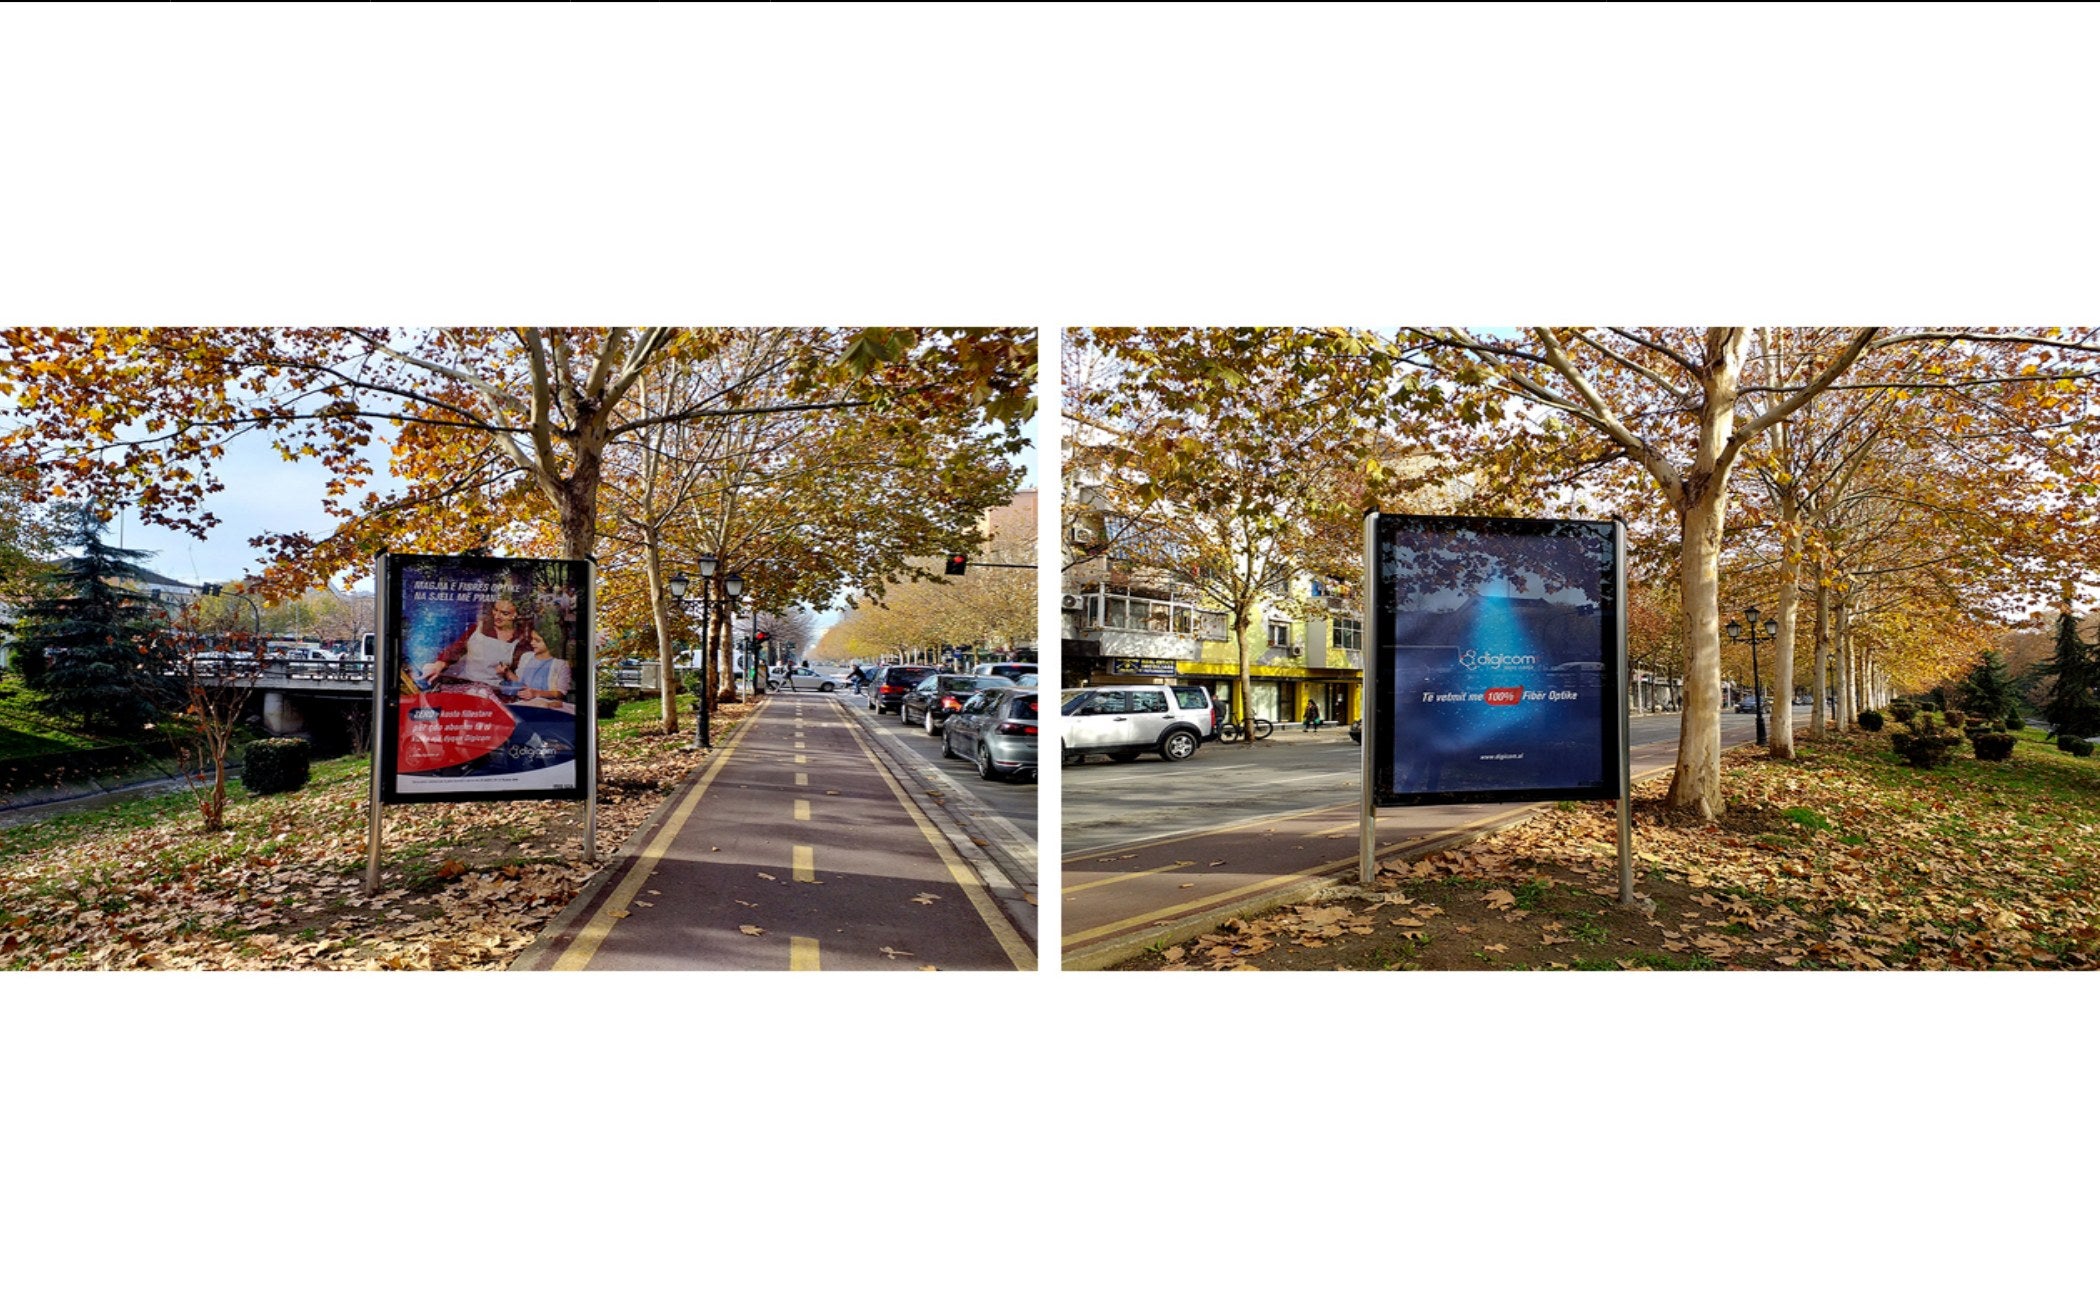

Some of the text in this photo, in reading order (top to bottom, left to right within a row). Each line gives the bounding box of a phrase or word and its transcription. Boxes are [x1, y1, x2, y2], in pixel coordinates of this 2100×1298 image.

[414, 592, 426, 600] NA
[429, 592, 454, 601] SJELL
[1477, 651, 1536, 669] digicom
[1488, 691, 1514, 701] 100%
[1548, 690, 1578, 702] Optike
